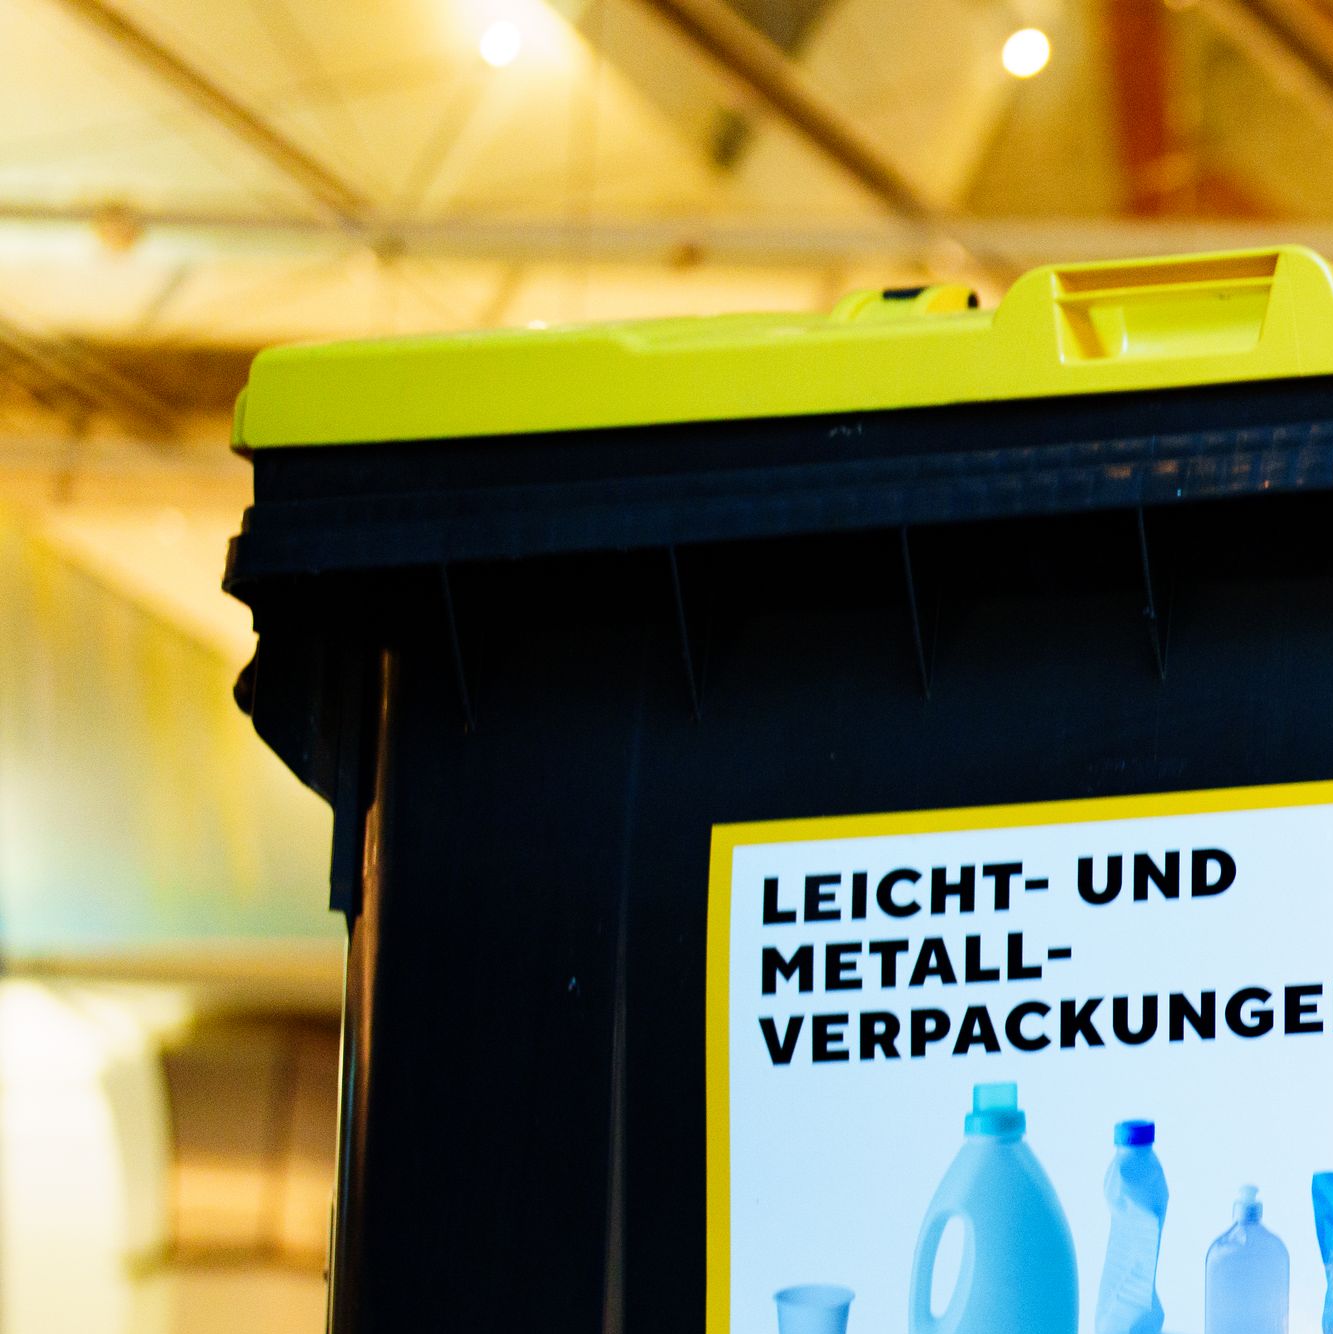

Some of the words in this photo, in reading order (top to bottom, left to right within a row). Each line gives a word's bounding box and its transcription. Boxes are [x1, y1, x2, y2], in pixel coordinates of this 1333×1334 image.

[762, 861, 1050, 926] LEICHT-
[1077, 847, 1237, 907] UND
[760, 931, 1073, 996] METALL-
